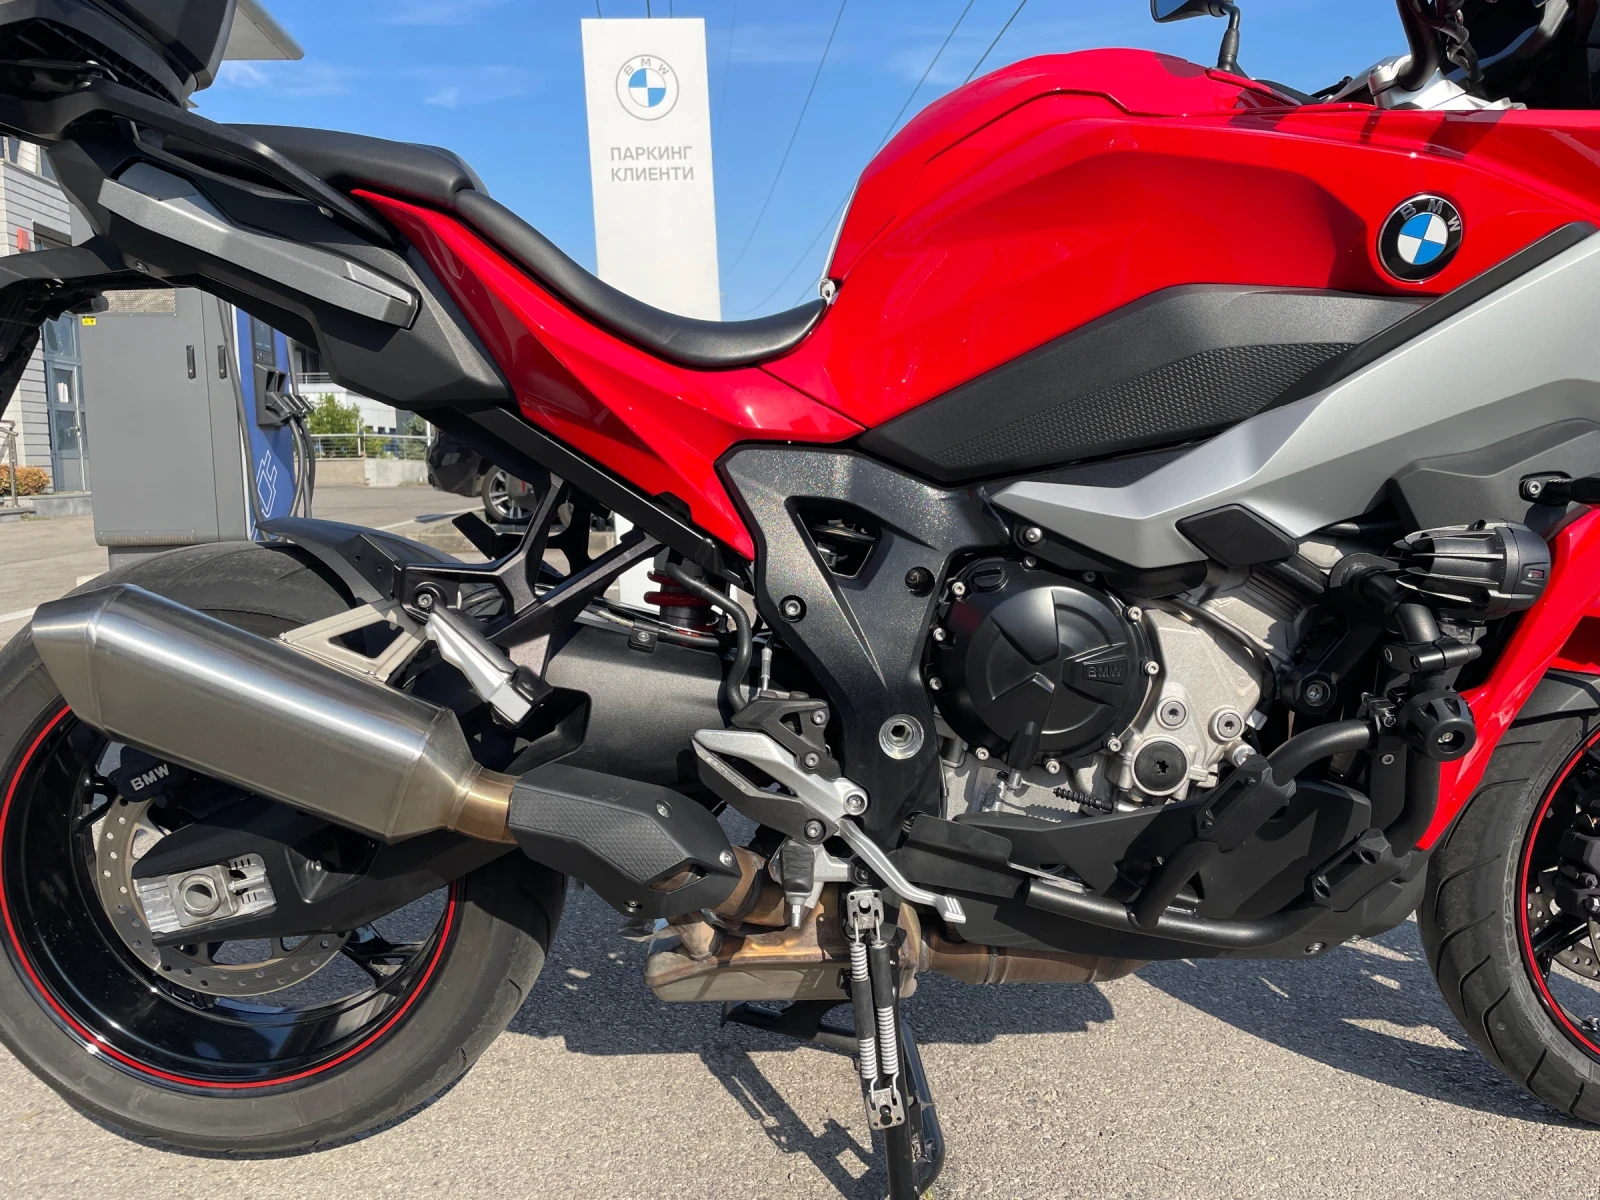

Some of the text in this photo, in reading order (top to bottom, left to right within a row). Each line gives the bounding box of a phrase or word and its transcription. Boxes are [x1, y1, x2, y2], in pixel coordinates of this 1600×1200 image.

[623, 58, 670, 76] BMW
[610, 146, 693, 161] ПАРКИНГ
[611, 166, 694, 182] КЛИЕНТИ
[1398, 198, 1461, 232] BMW
[1088, 666, 1123, 678] BMW
[130, 763, 170, 791] BMW
